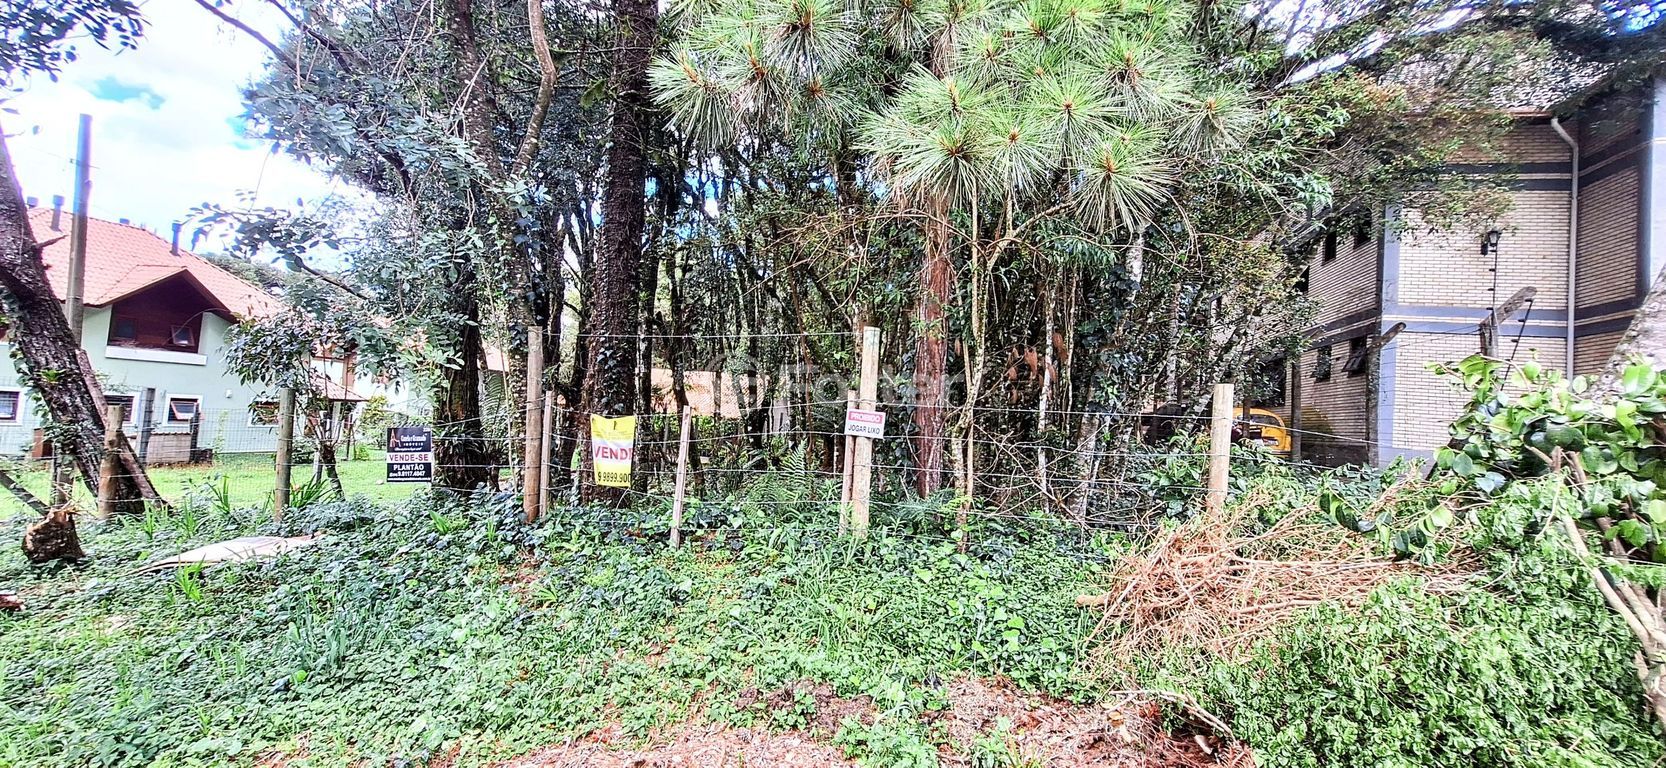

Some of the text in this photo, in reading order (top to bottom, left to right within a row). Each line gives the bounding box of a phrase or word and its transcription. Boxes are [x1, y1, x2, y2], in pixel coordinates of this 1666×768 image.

[850, 412, 881, 422] PROIBIDO
[848, 424, 880, 434] JOGAR LIXO
[389, 454, 429, 462] VENDE-SE
